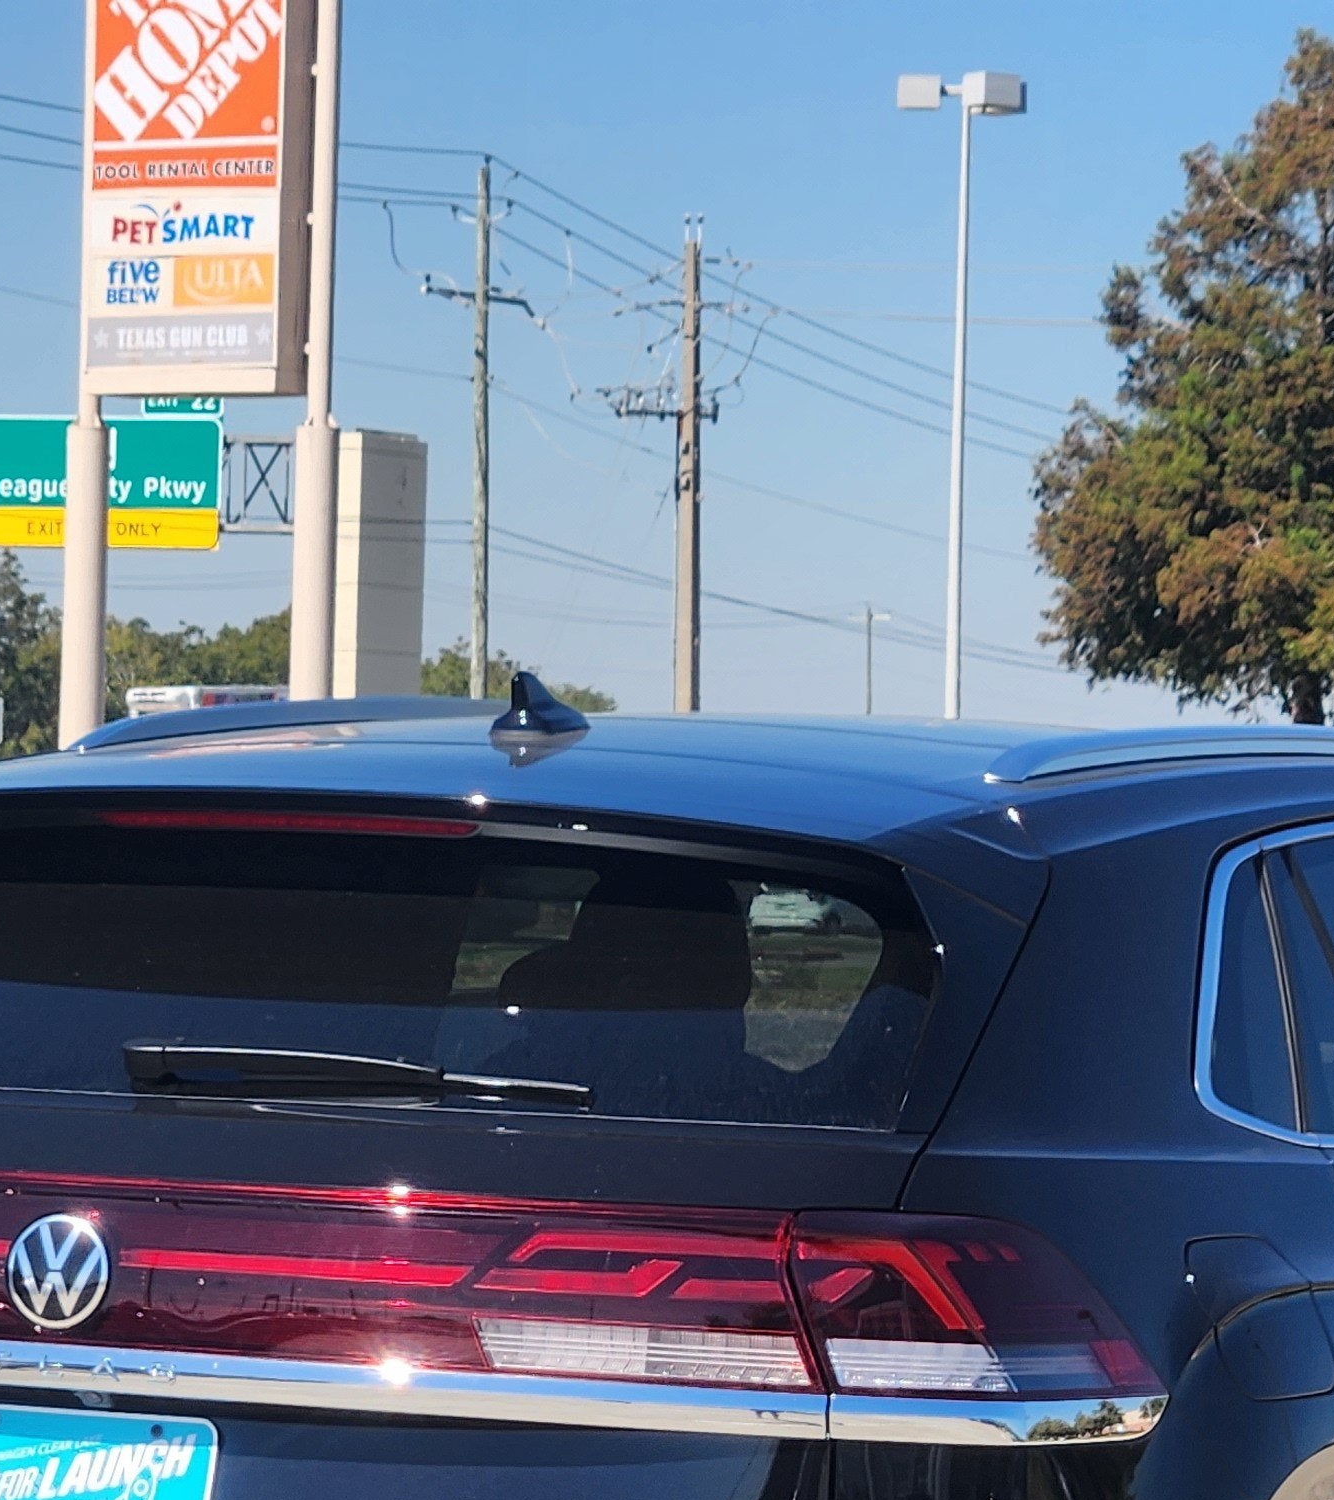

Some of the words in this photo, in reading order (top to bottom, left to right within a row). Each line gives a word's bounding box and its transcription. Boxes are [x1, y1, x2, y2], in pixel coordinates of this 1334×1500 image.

[94, 0, 257, 142] HOM
[162, 0, 281, 139] DEPOT
[95, 163, 139, 179] TOOL
[147, 161, 207, 177] RENTAL
[214, 159, 275, 176] CENTER
[107, 260, 161, 285] five
[194, 259, 266, 290] ULTA
[117, 327, 166, 350] TEXAS
[169, 326, 203, 348] GUN
[205, 323, 249, 348] CLUB
[108, 476, 133, 504] ty
[143, 475, 207, 505] Pkwy
[27, 521, 63, 536] EXIT
[116, 521, 162, 537] ONLY
[36, 1433, 197, 1500] LAUNCH
